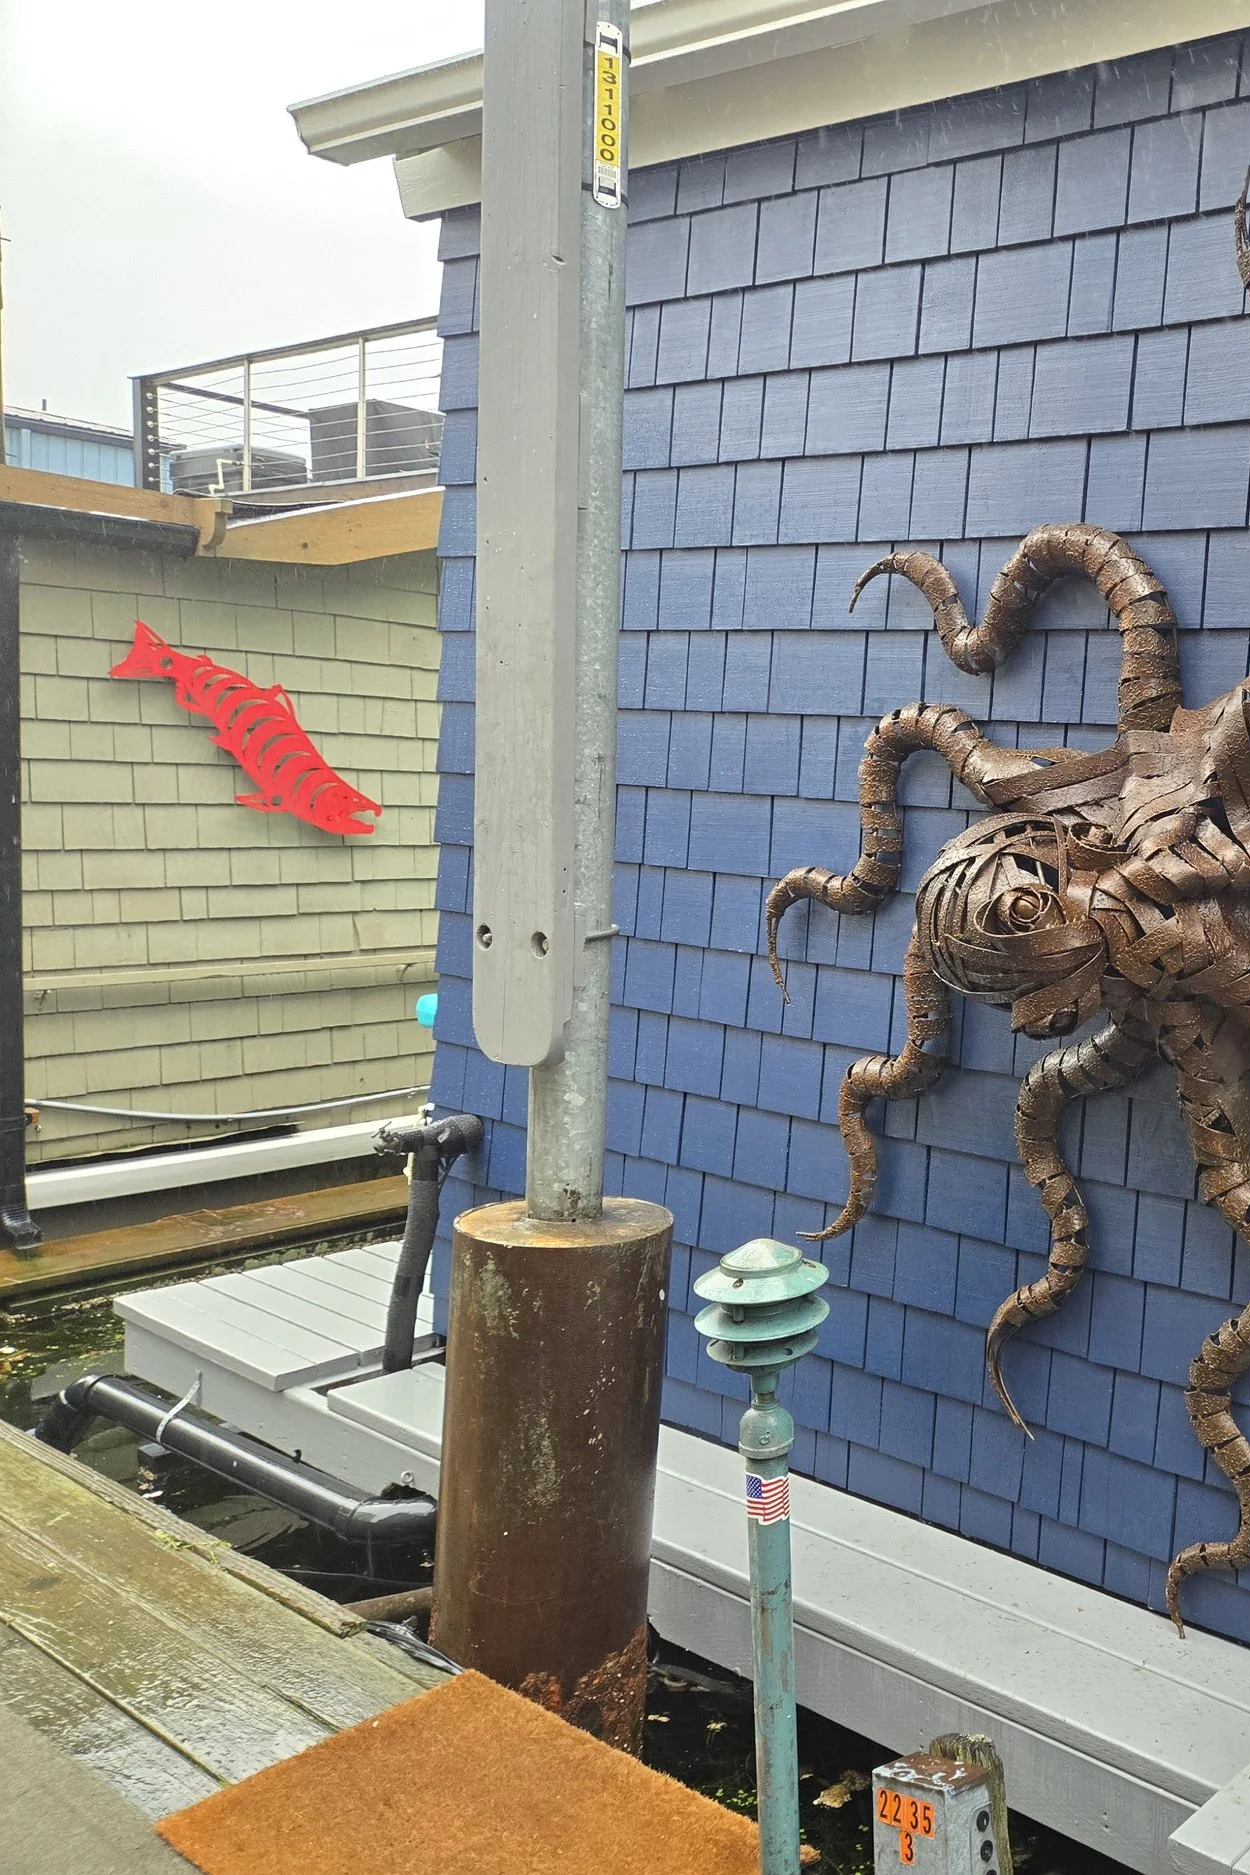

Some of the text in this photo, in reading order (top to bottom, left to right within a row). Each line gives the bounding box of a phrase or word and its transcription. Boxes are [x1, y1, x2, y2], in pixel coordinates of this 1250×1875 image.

[600, 56, 617, 161] 1311000
[880, 1790, 932, 1835] 2235
[905, 1832, 914, 1862] 3
